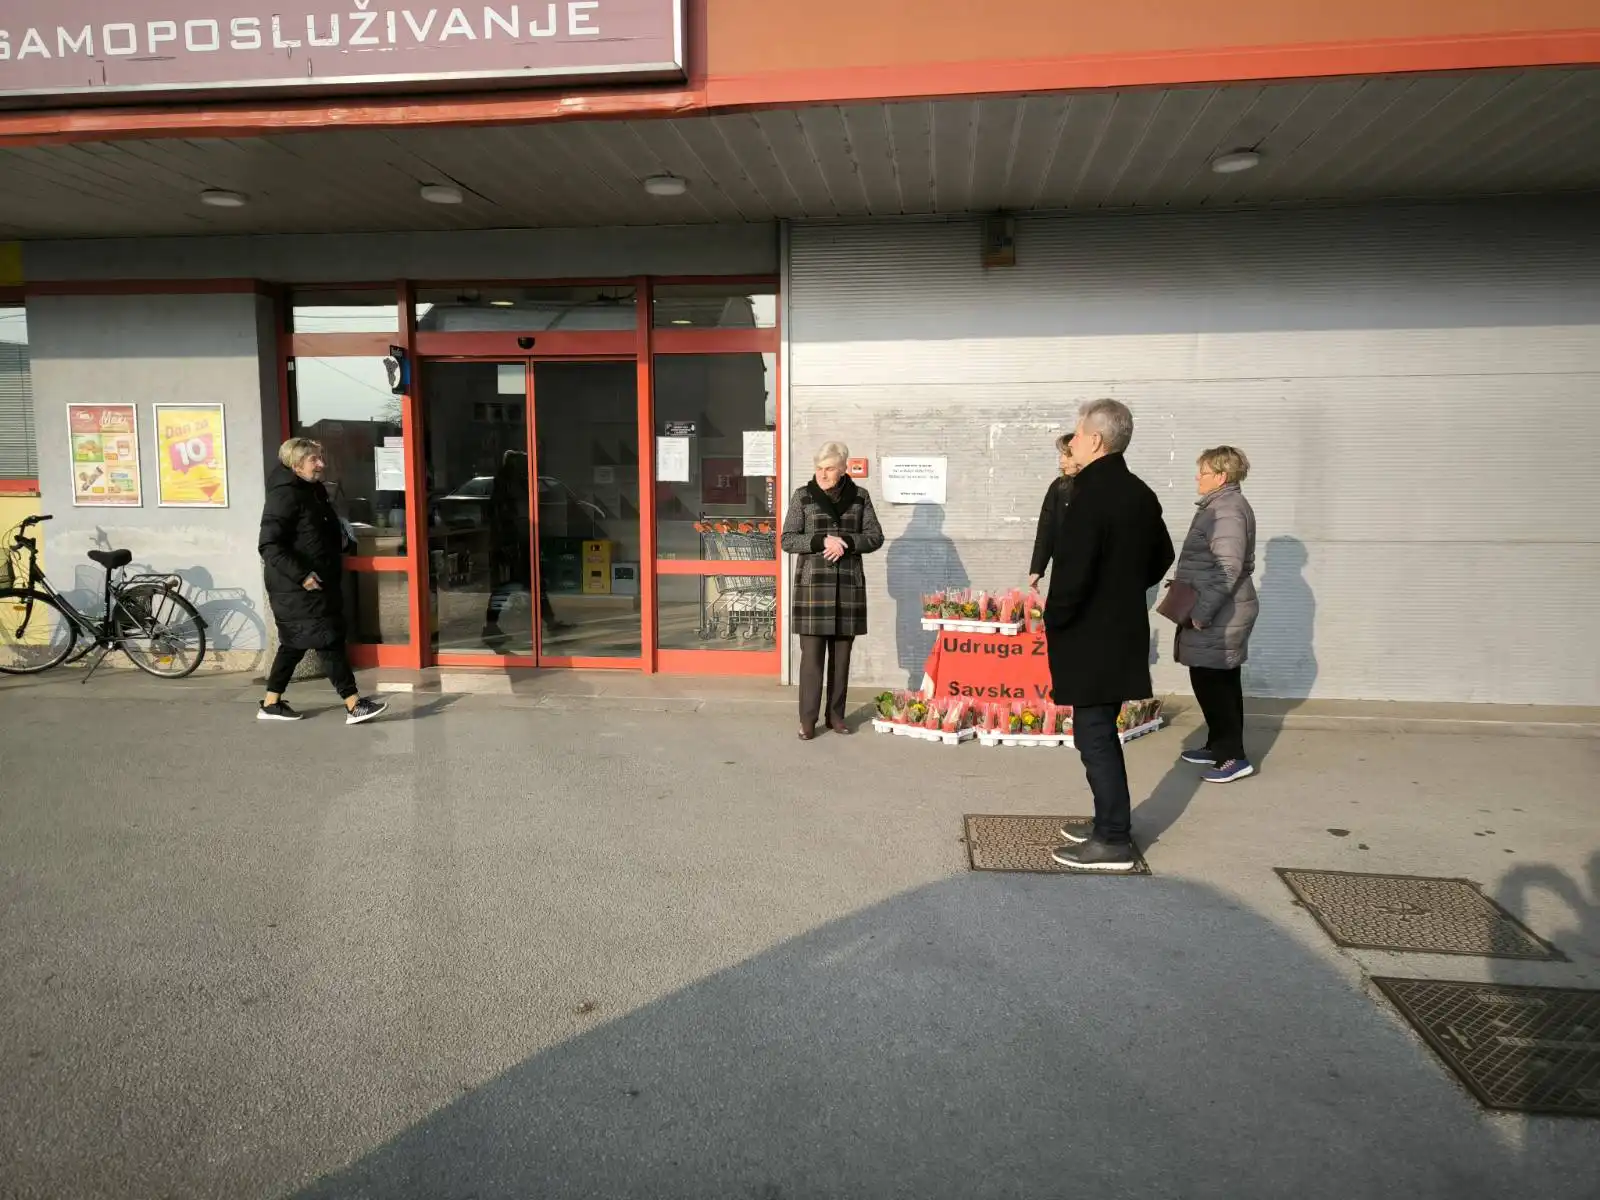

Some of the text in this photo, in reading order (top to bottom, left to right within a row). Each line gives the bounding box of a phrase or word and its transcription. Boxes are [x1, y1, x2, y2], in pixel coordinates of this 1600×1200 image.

[174, 437, 206, 466] 10
[943, 636, 1046, 659] Udruga Ž
[949, 681, 1025, 699] Savska
